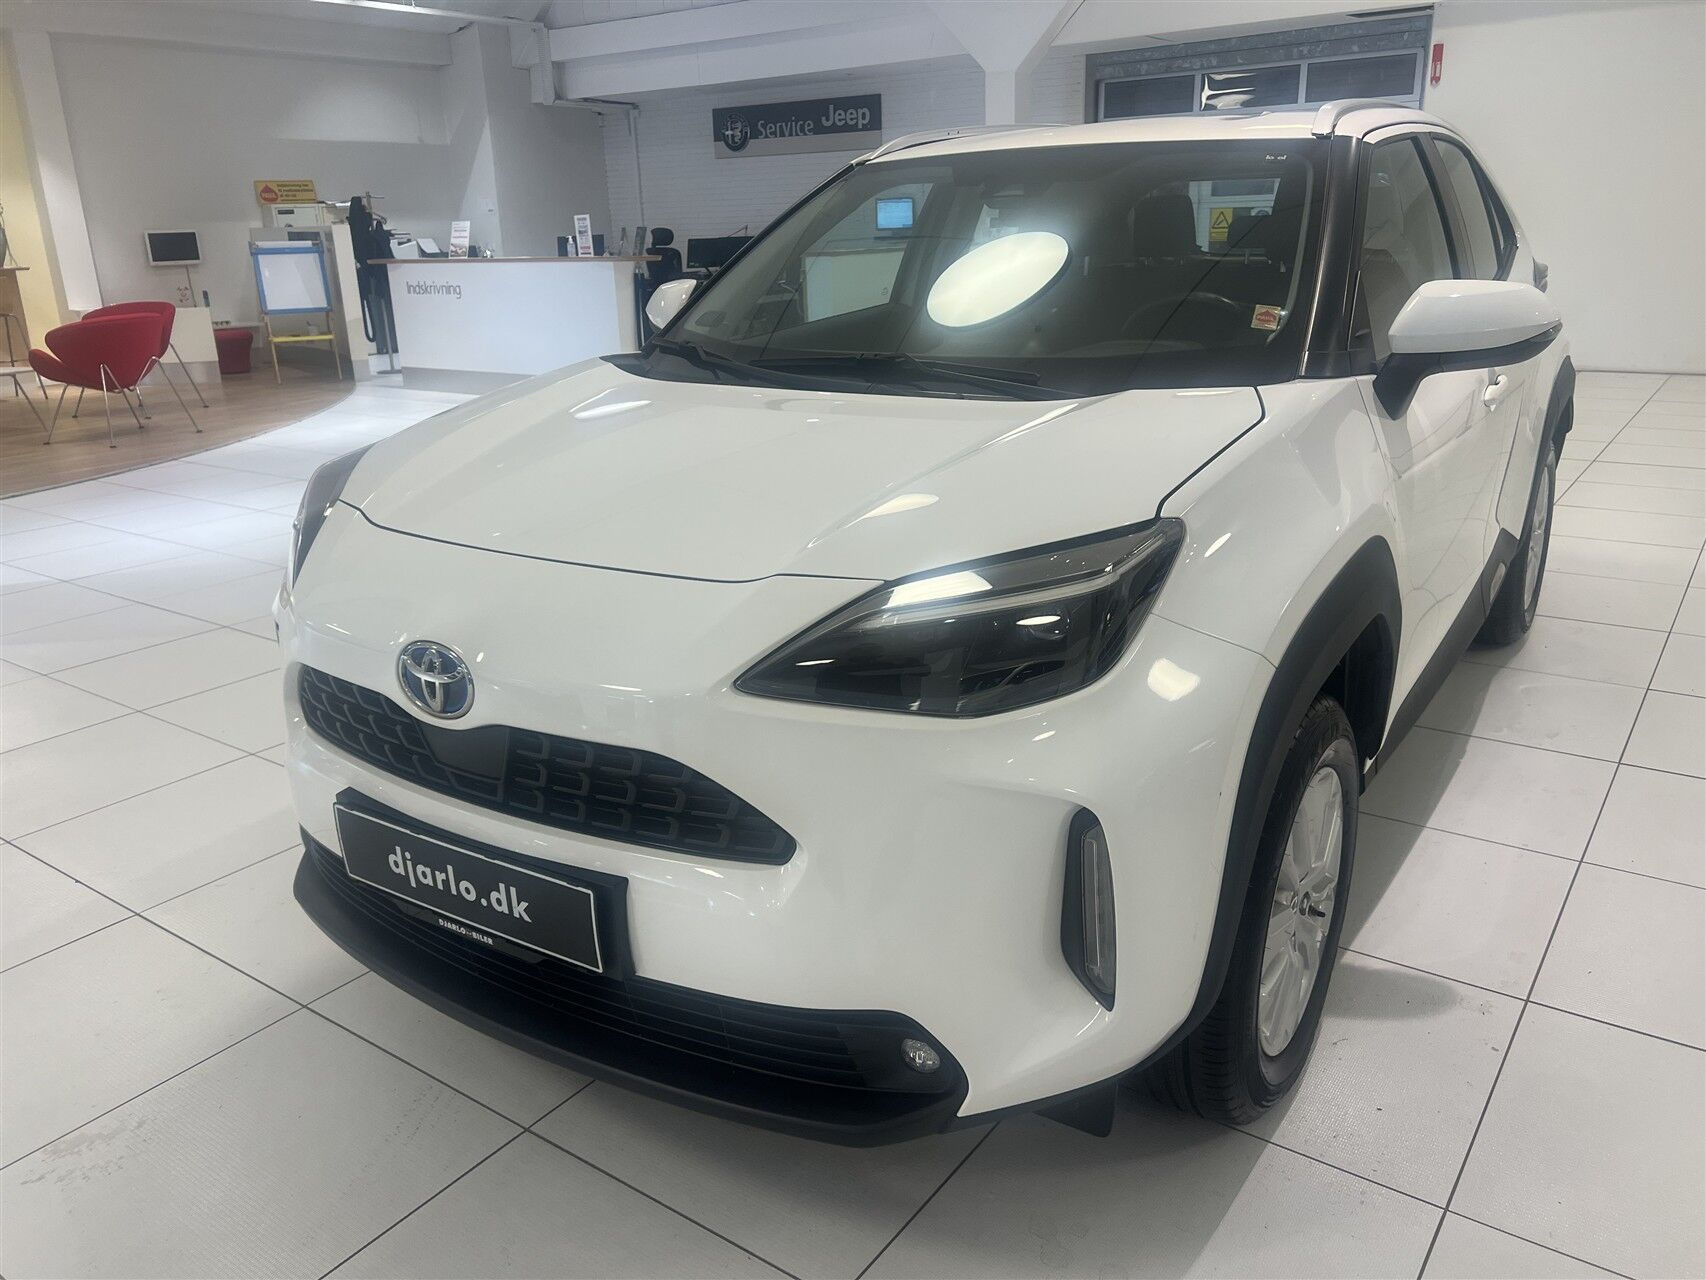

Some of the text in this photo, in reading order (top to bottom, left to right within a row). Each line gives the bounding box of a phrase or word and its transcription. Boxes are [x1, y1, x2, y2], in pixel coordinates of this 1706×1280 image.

[757, 116, 814, 139] Service
[821, 104, 871, 129] Jeep
[406, 280, 462, 300] Indskrivning
[388, 845, 532, 923] djarlo.dk
